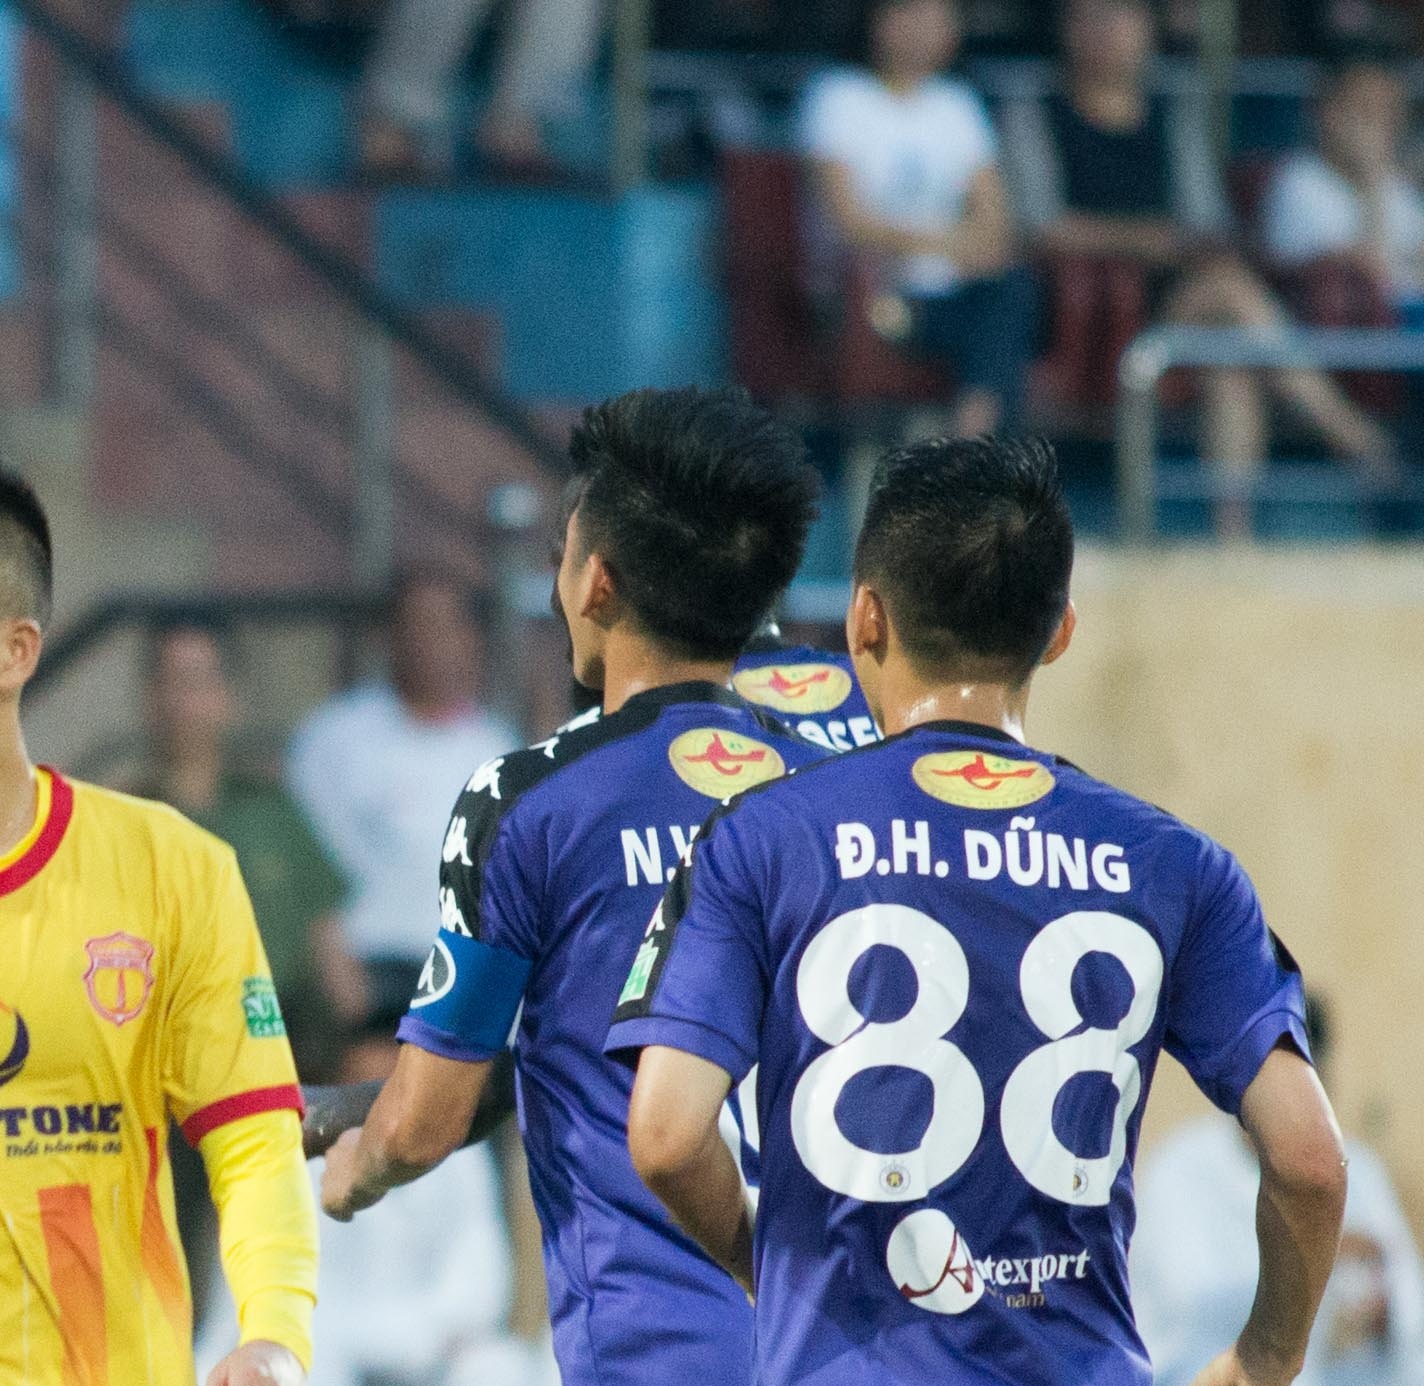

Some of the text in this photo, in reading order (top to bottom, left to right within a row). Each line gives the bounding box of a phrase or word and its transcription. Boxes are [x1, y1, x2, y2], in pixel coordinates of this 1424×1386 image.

[835, 816, 1132, 893] Đ.H. DŨNG
[789, 903, 1165, 1205] 88
